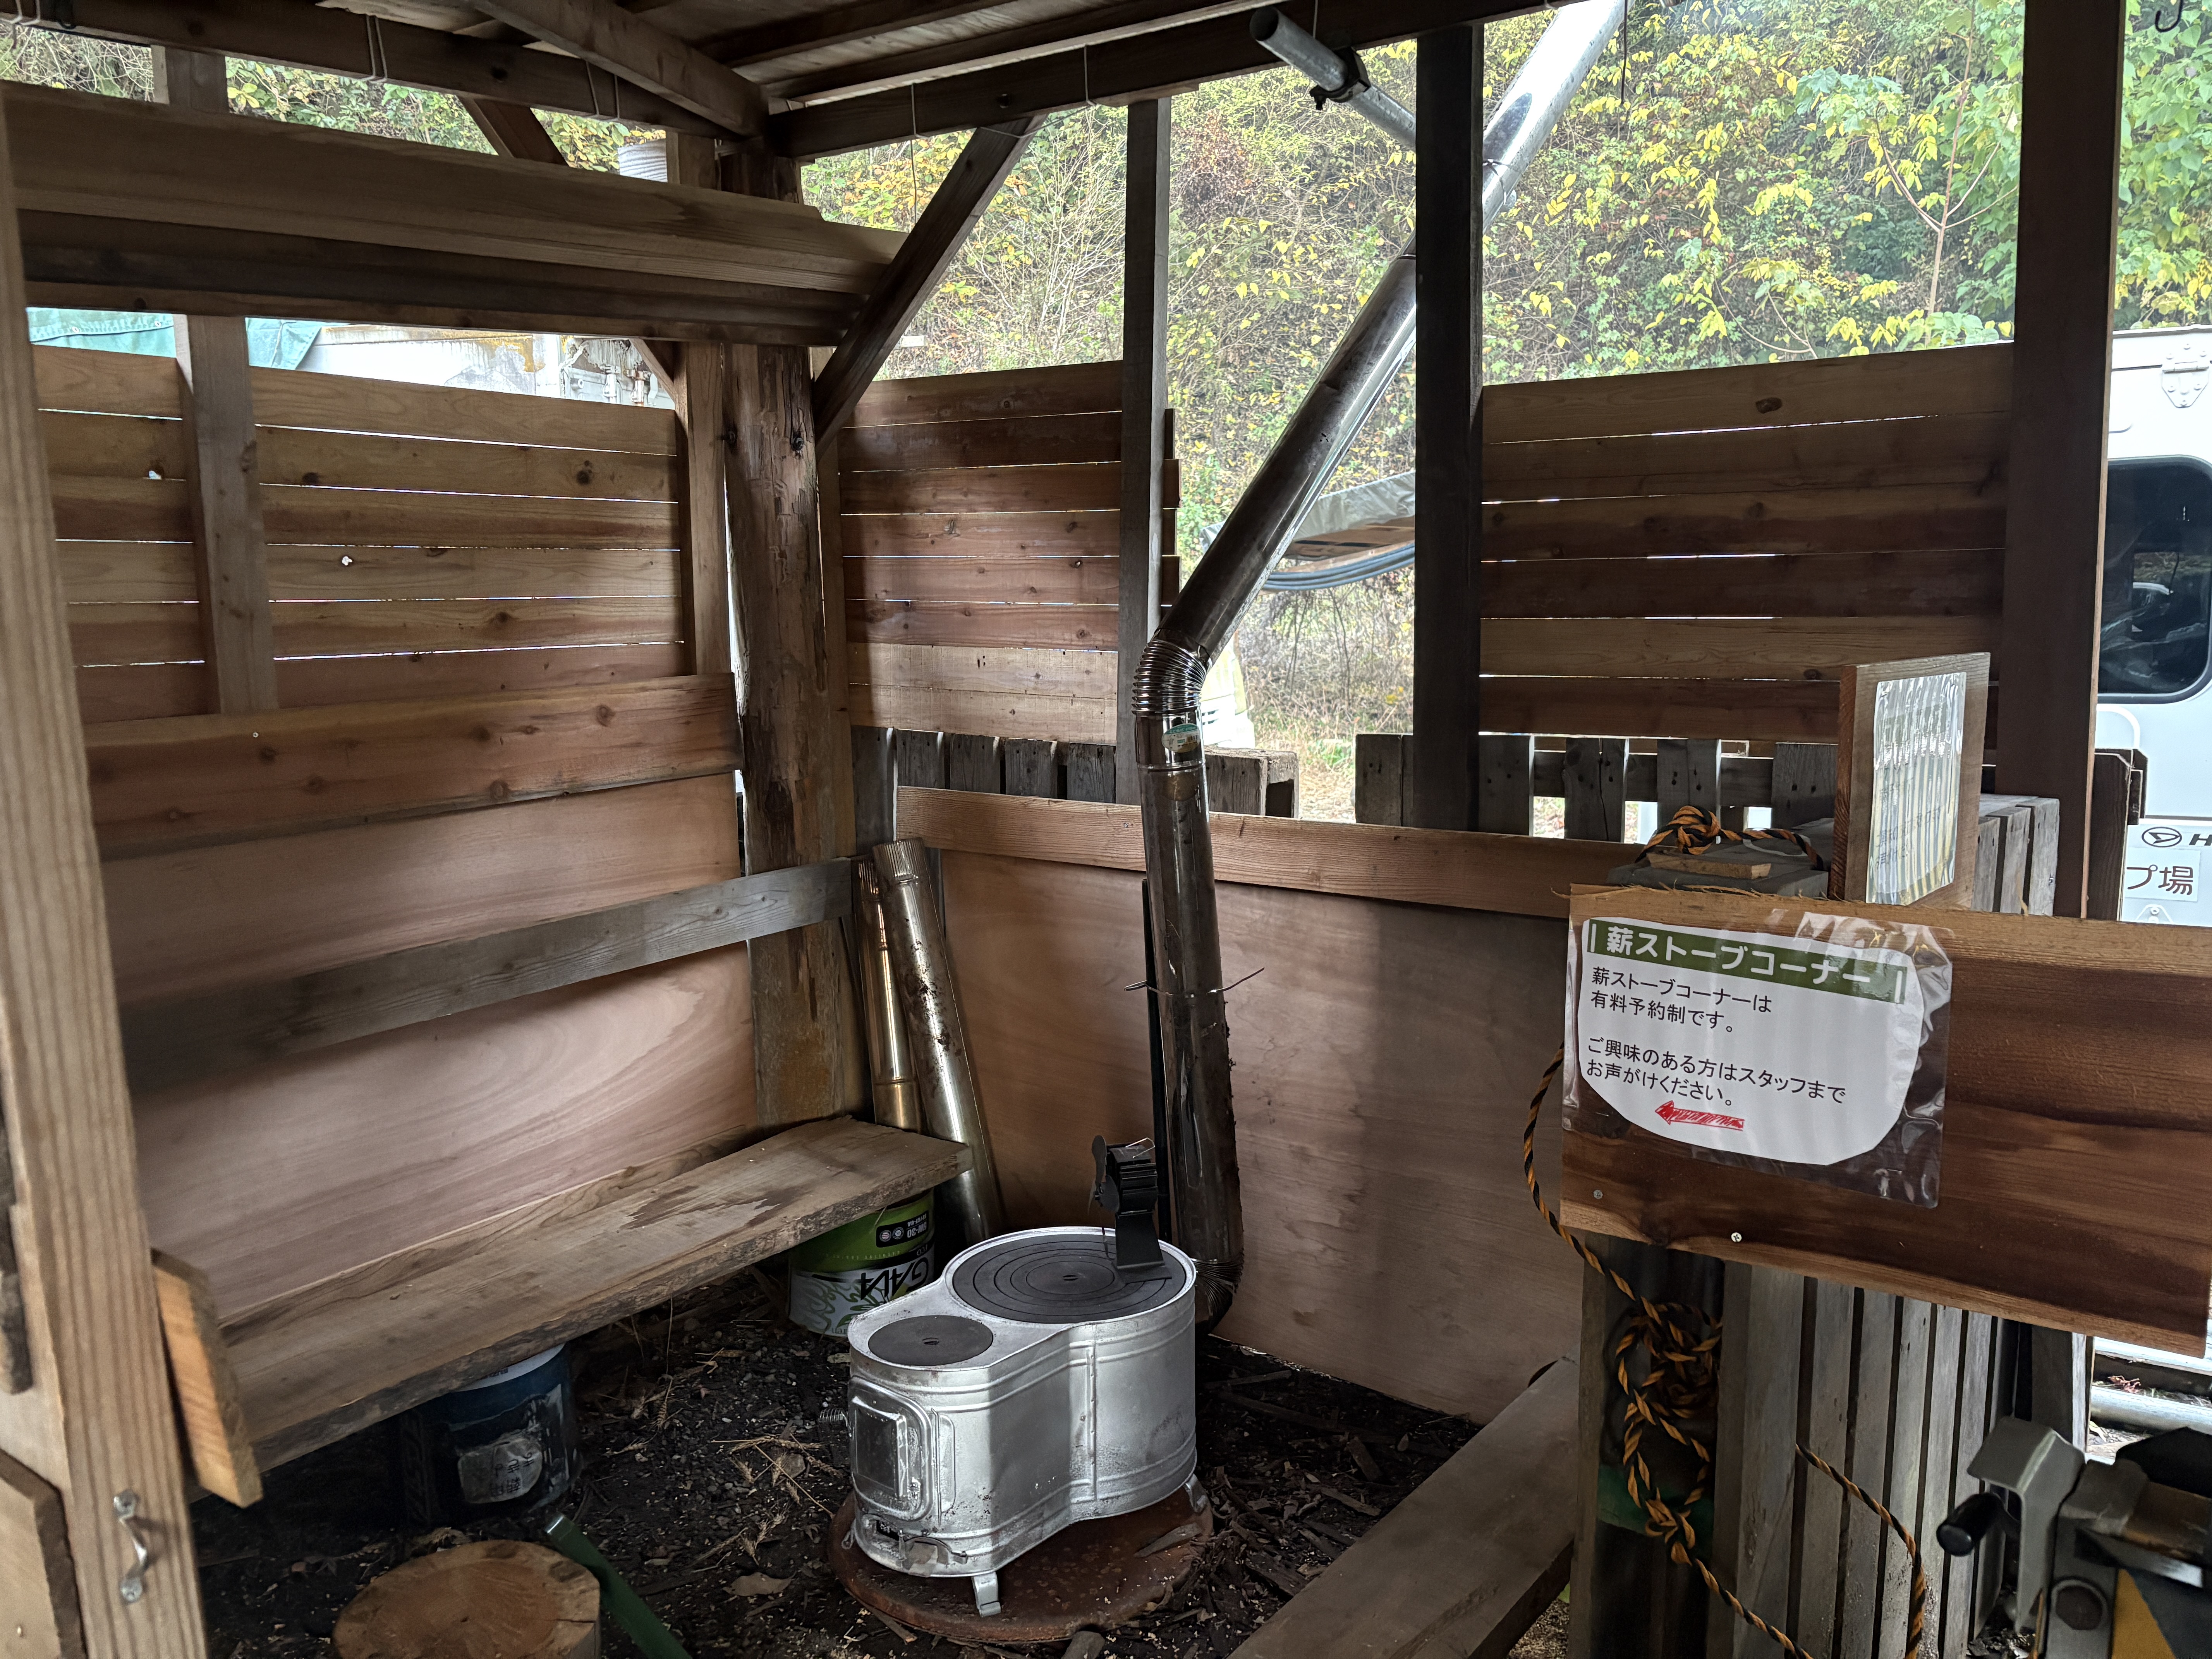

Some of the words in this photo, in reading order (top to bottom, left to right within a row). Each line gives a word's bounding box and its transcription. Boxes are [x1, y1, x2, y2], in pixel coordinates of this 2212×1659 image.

[2126, 864, 2193, 895] プ場
[1607, 926, 1871, 985] 薪ストーブコーナー
[1590, 990, 1733, 1032] 有料予約制です。
[1592, 967, 1772, 1012] 薪ストーブコーナーは
[1587, 1059, 1733, 1106] お声がけください。
[1588, 1037, 1846, 1104] ご興味のある方はスタッフまで
